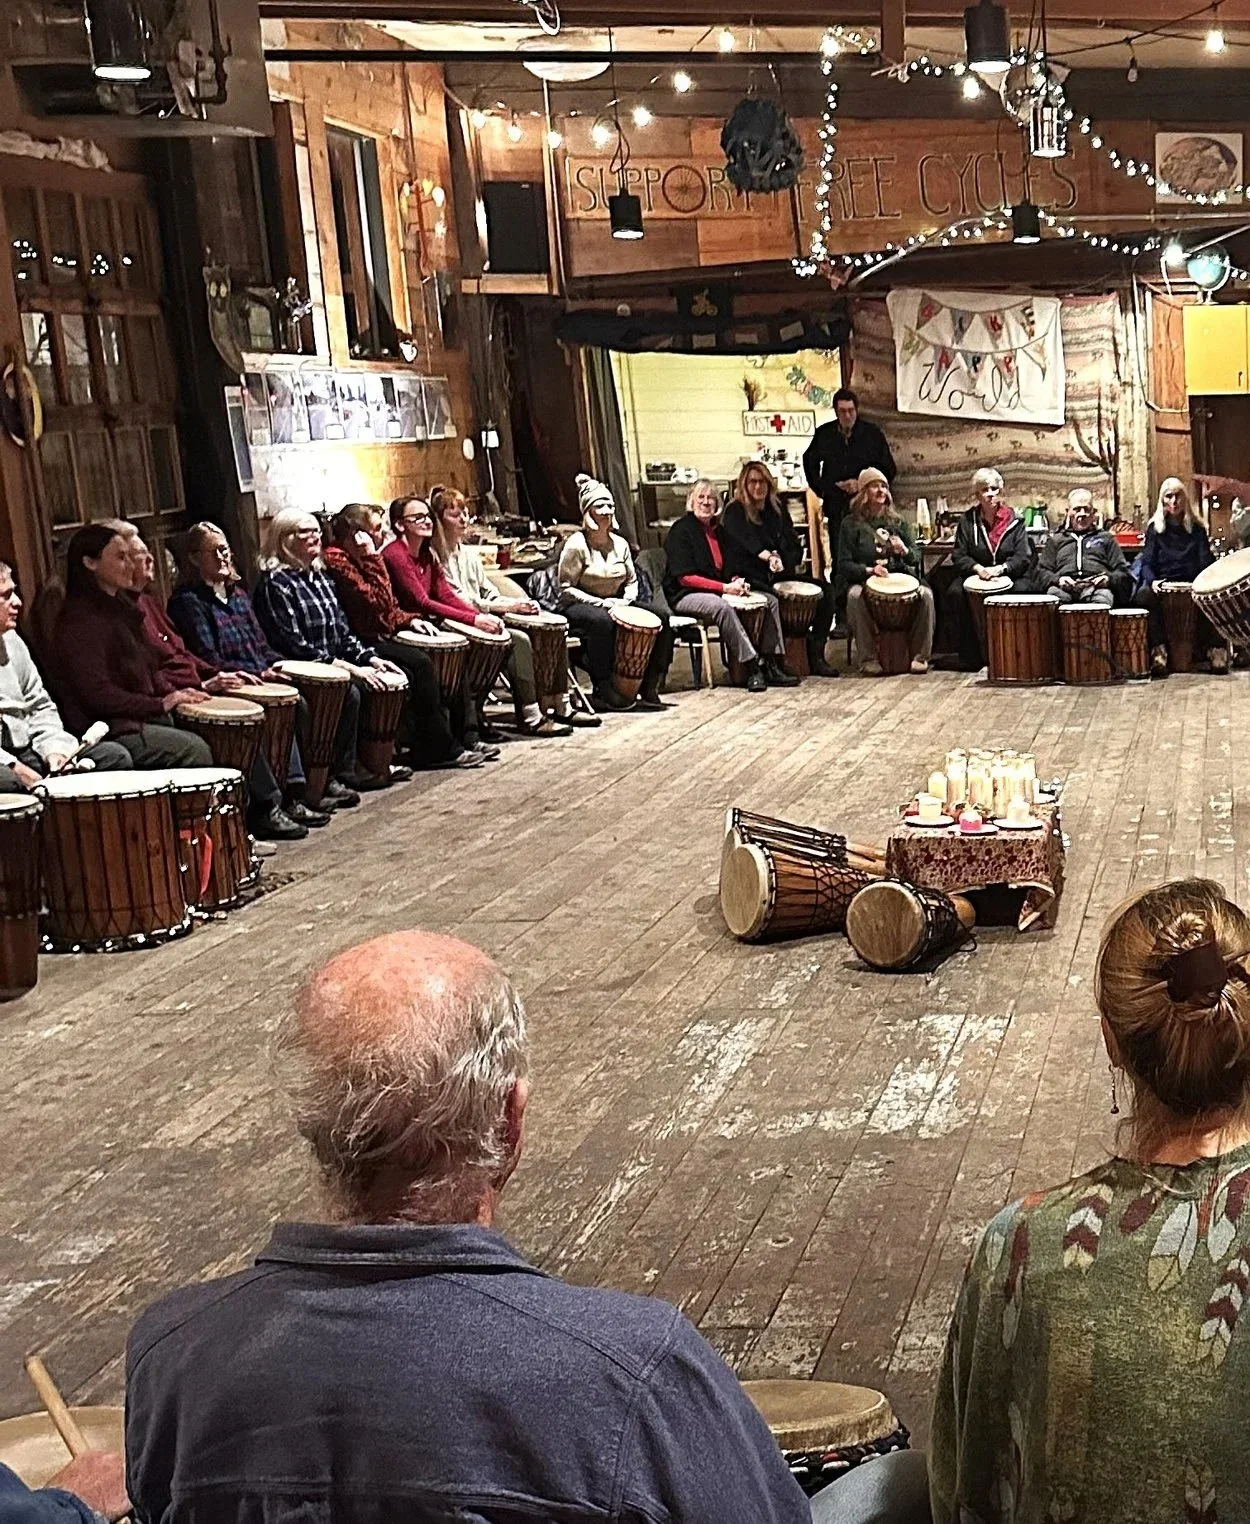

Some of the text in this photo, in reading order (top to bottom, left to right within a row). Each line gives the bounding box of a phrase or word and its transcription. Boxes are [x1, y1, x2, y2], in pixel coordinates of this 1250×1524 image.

[796, 155, 901, 222] FREE
[919, 362, 1026, 413] World
[745, 415, 812, 433] FIRST AID
